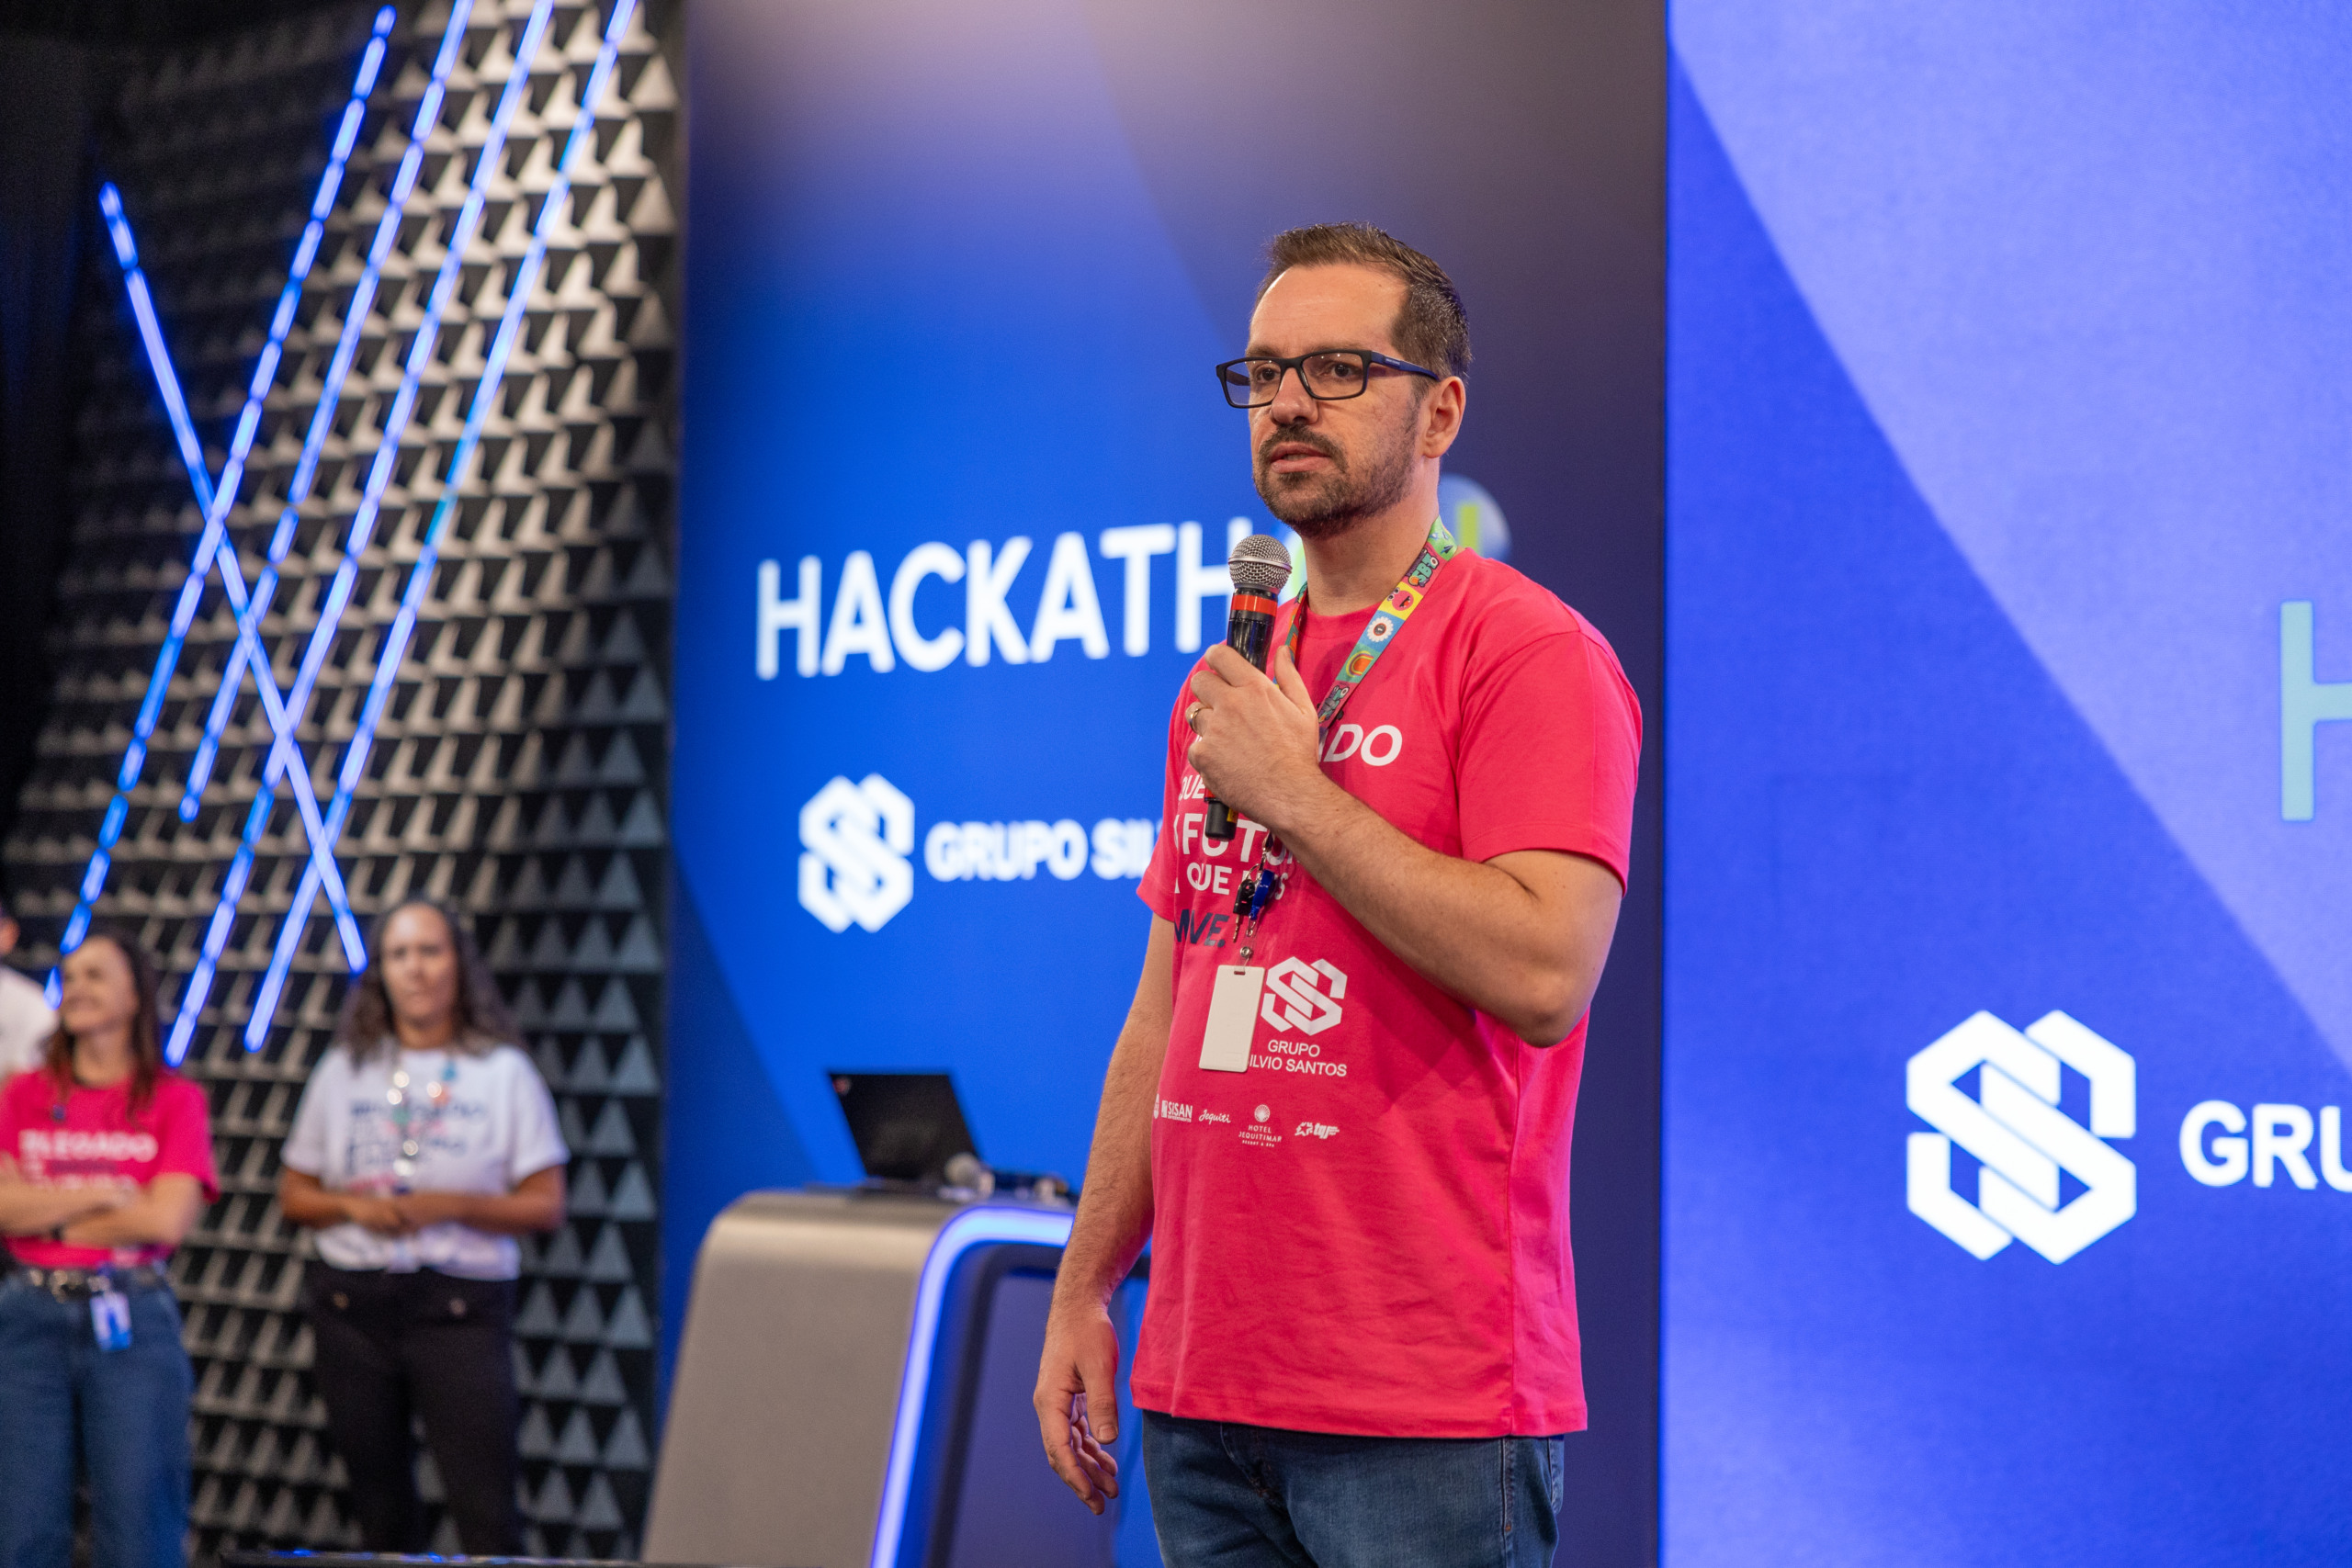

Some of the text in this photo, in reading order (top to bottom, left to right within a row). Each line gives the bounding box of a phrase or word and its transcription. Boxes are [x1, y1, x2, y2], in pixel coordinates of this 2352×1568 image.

[756, 516, 1306, 681] HACKATH
[1317, 723, 1403, 767] DO
[924, 819, 1088, 882] GRUPO
[1186, 863, 1232, 896] QUE
[1268, 1039, 1320, 1057] GRUPO
[1247, 1054, 1347, 1077] ILVIO SANTOS
[1198, 1109, 1231, 1125] Jequiti
[1238, 1131, 1283, 1143] JEQUITIMAR
[1248, 1124, 1272, 1134] HOTEL
